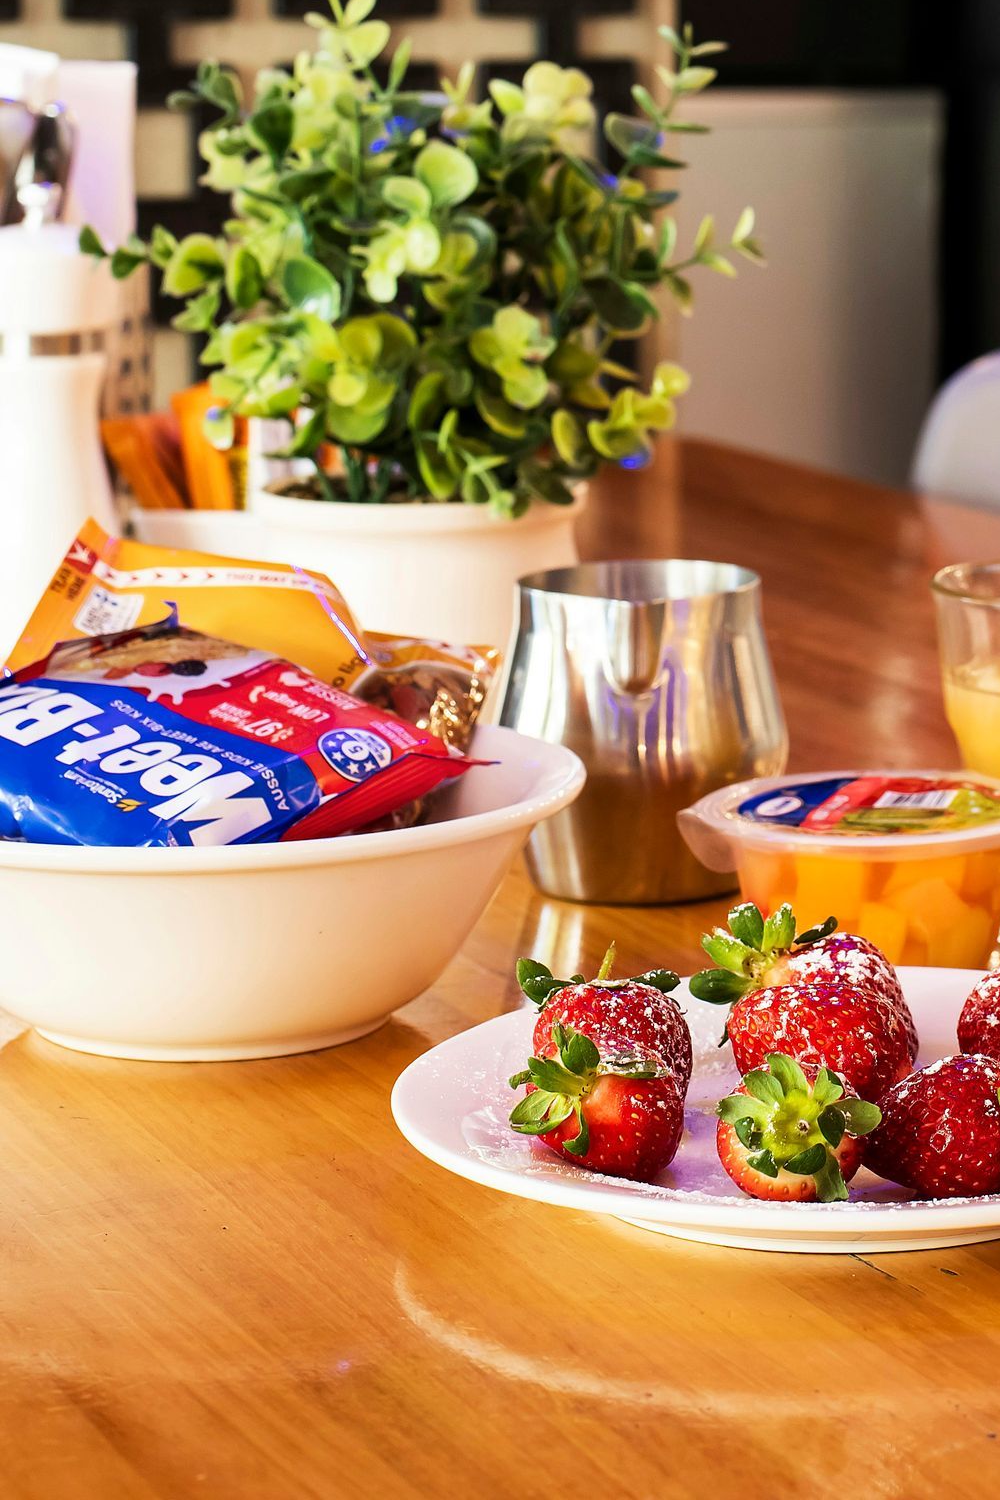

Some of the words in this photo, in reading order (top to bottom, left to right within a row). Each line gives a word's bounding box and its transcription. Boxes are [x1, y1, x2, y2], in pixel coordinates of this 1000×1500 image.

[261, 690, 298, 708] sugar
[110, 700, 142, 720] KIDS
[286, 704, 331, 724] LOW
[139, 717, 198, 745] WEET-BIX
[196, 741, 225, 756] ARE
[347, 744, 364, 755] 5
[0, 685, 273, 847] Weet-Bi
[221, 751, 254, 767] KIDS
[250, 762, 290, 811] AUSSIE
